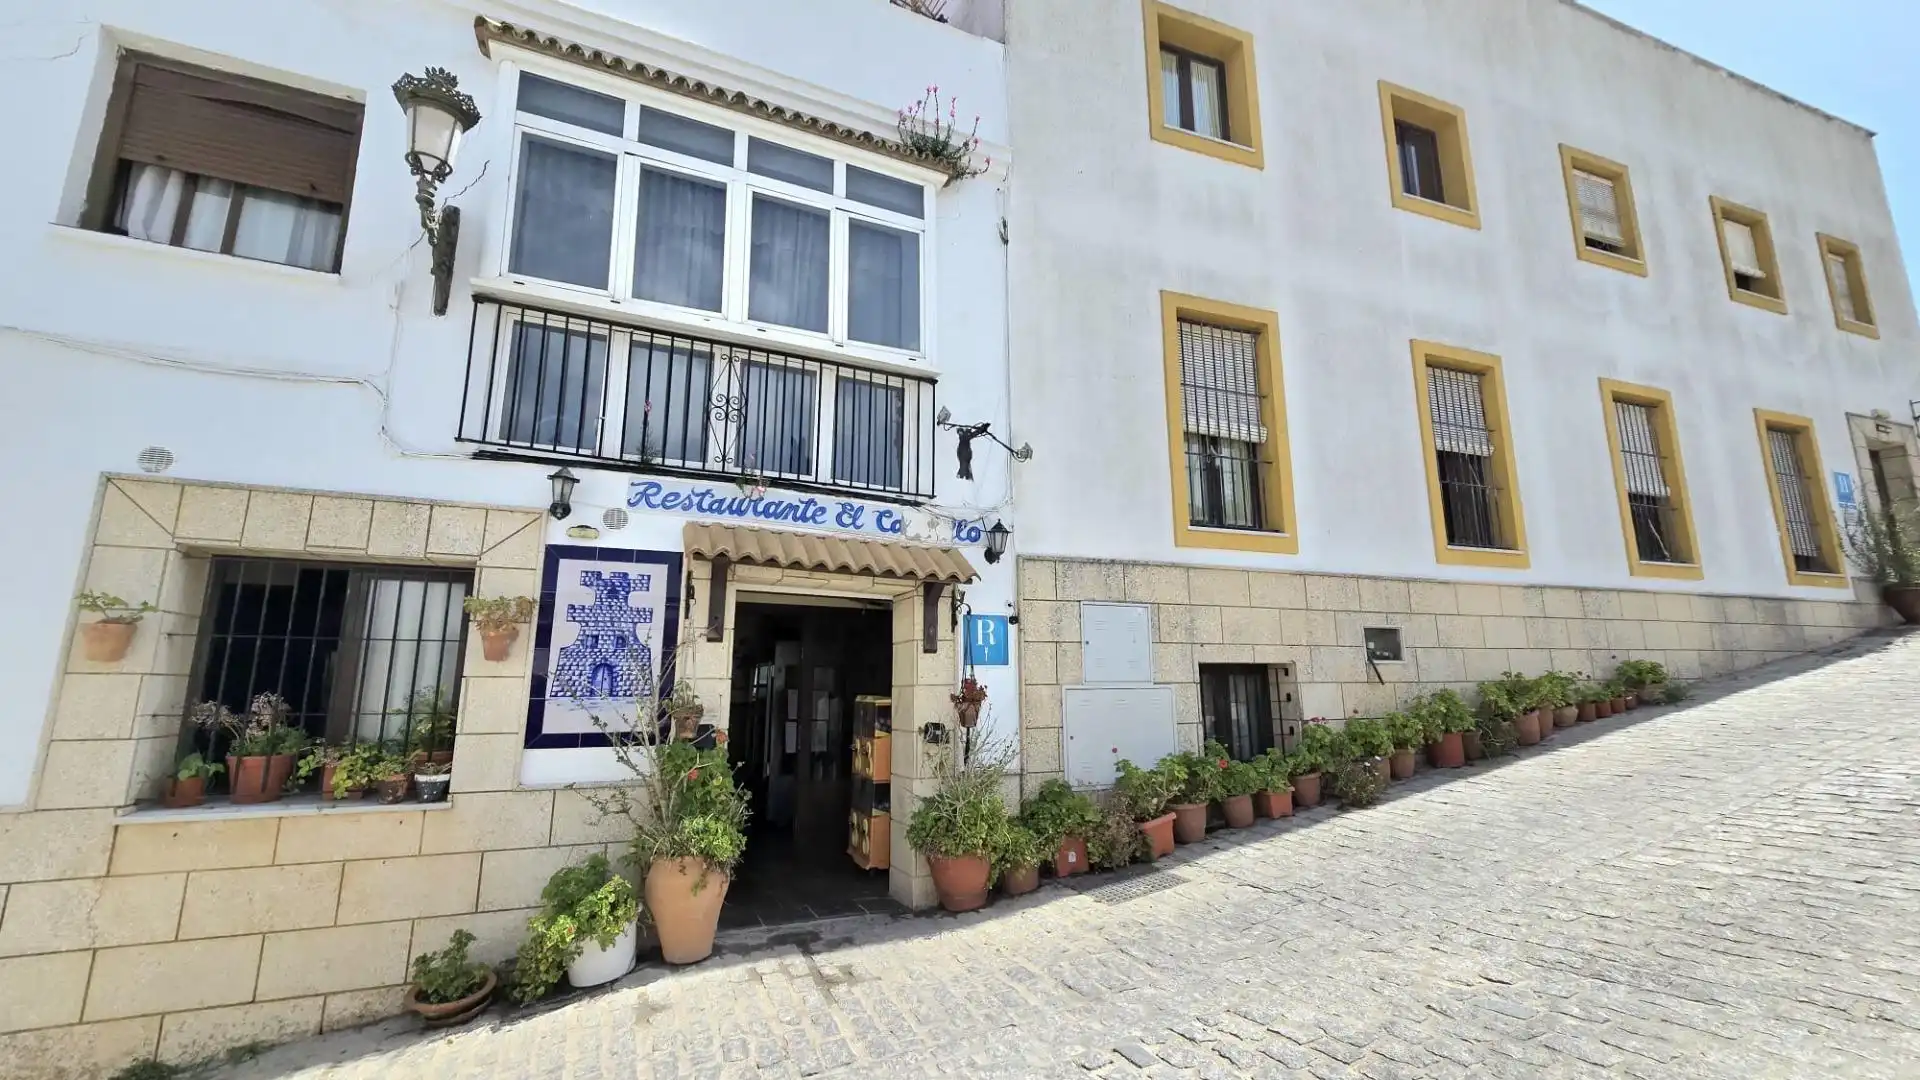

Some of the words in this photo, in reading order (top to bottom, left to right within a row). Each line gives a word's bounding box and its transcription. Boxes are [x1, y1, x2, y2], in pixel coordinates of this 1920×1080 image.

[627, 481, 827, 525] Restaurante
[835, 502, 865, 529] El
[976, 619, 996, 646] R
